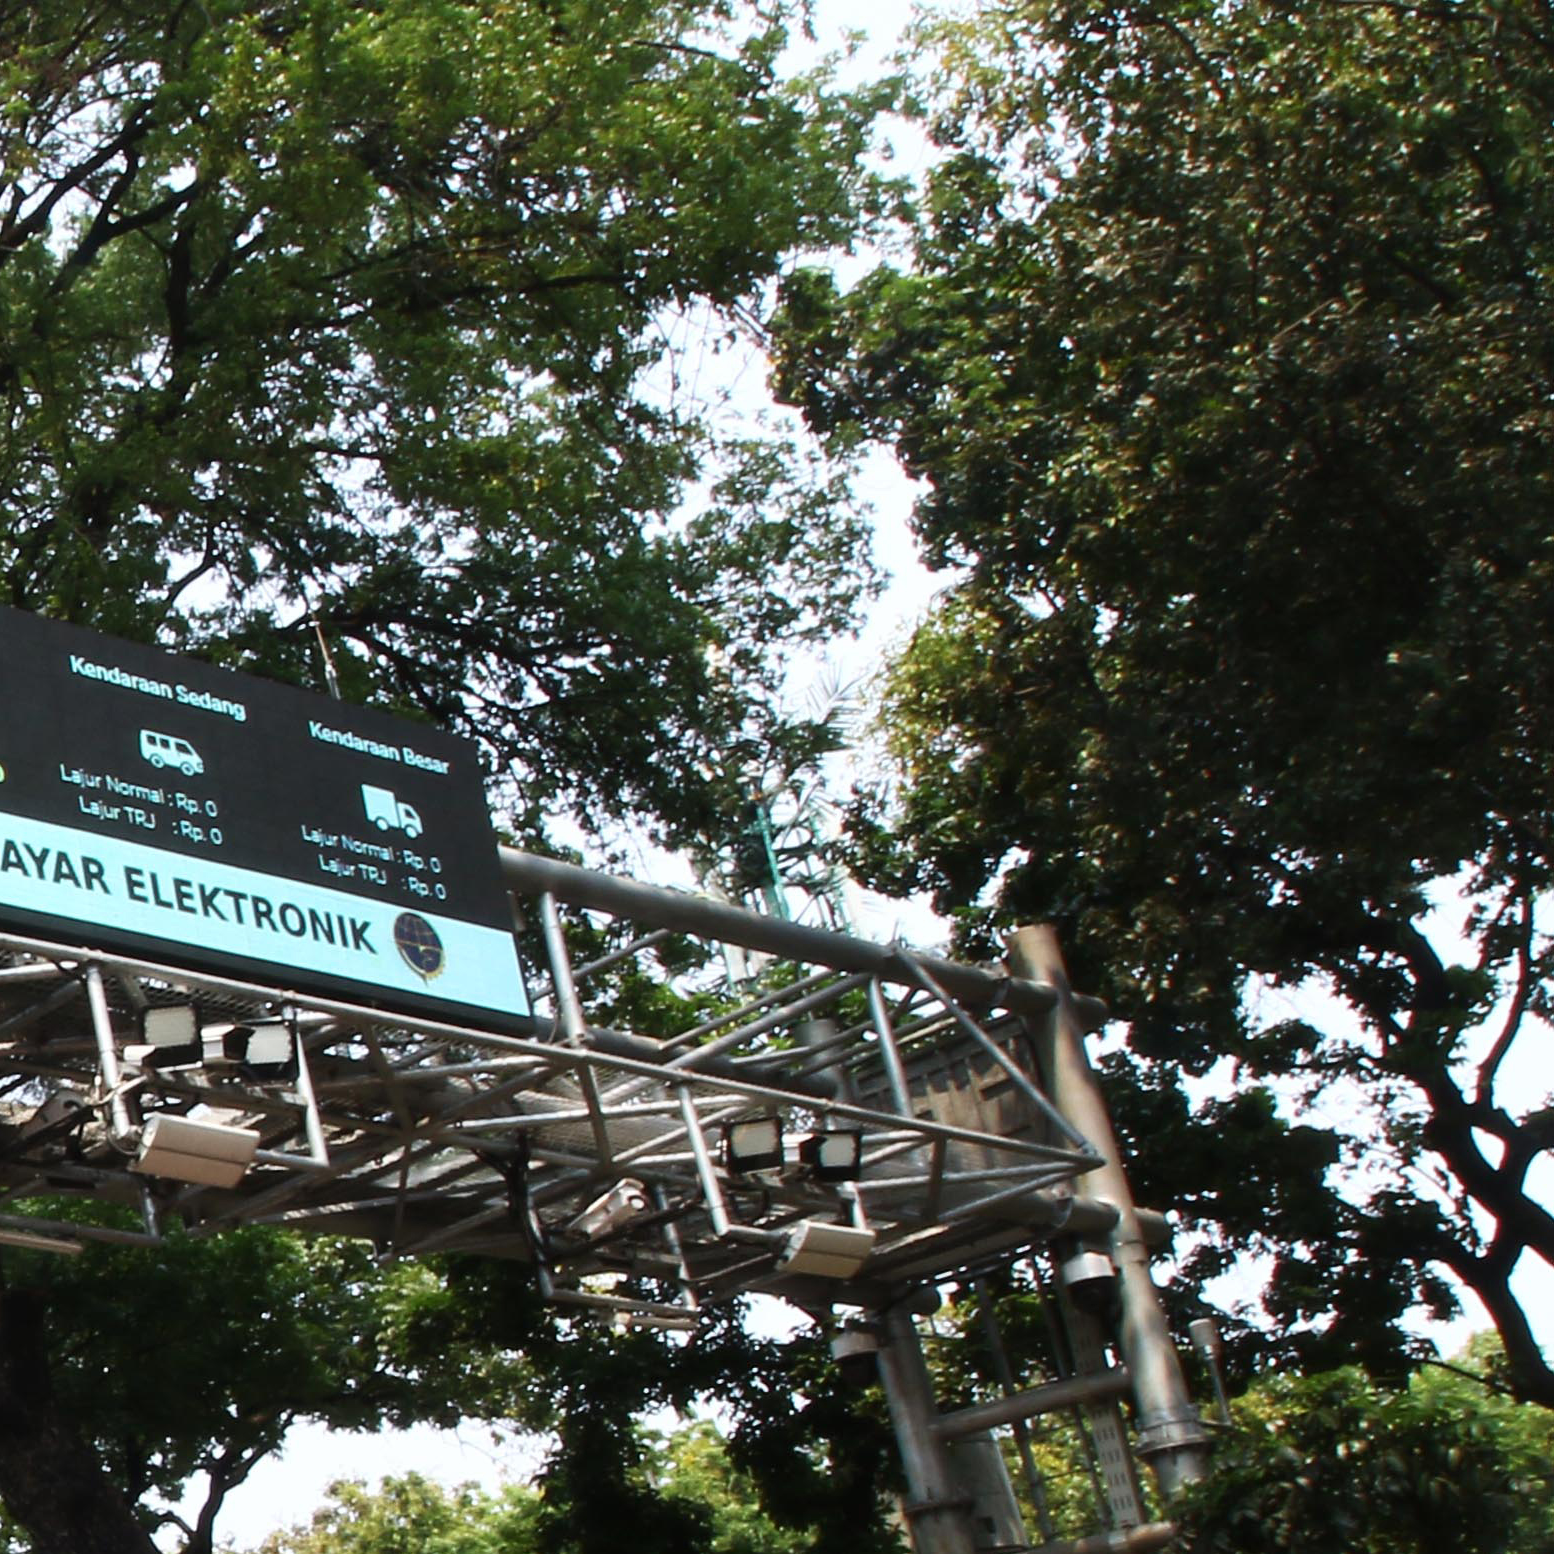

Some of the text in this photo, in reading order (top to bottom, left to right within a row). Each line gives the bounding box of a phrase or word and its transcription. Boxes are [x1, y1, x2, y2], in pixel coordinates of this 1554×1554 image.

[69, 654, 247, 722] Kendaraan Sedang
[308, 720, 450, 775] Kendaraan Besar
[59, 763, 103, 789] Lajur
[105, 774, 165, 804] Normal
[174, 792, 203, 815] Rp.
[204, 800, 218, 818] 0
[78, 795, 121, 821] Lajur
[122, 805, 156, 829] TRJ
[179, 819, 208, 843] Rp.
[209, 827, 223, 845] 0
[301, 824, 339, 848] Lajur
[340, 834, 395, 861] Normal
[402, 849, 428, 871] Rp.
[429, 856, 442, 874] 0
[318, 853, 356, 877] Lajur
[357, 863, 387, 885] TRJ
[407, 876, 434, 897] Rp.
[434, 883, 447, 900] 0
[122, 865, 379, 955] ELEKTRONIK
